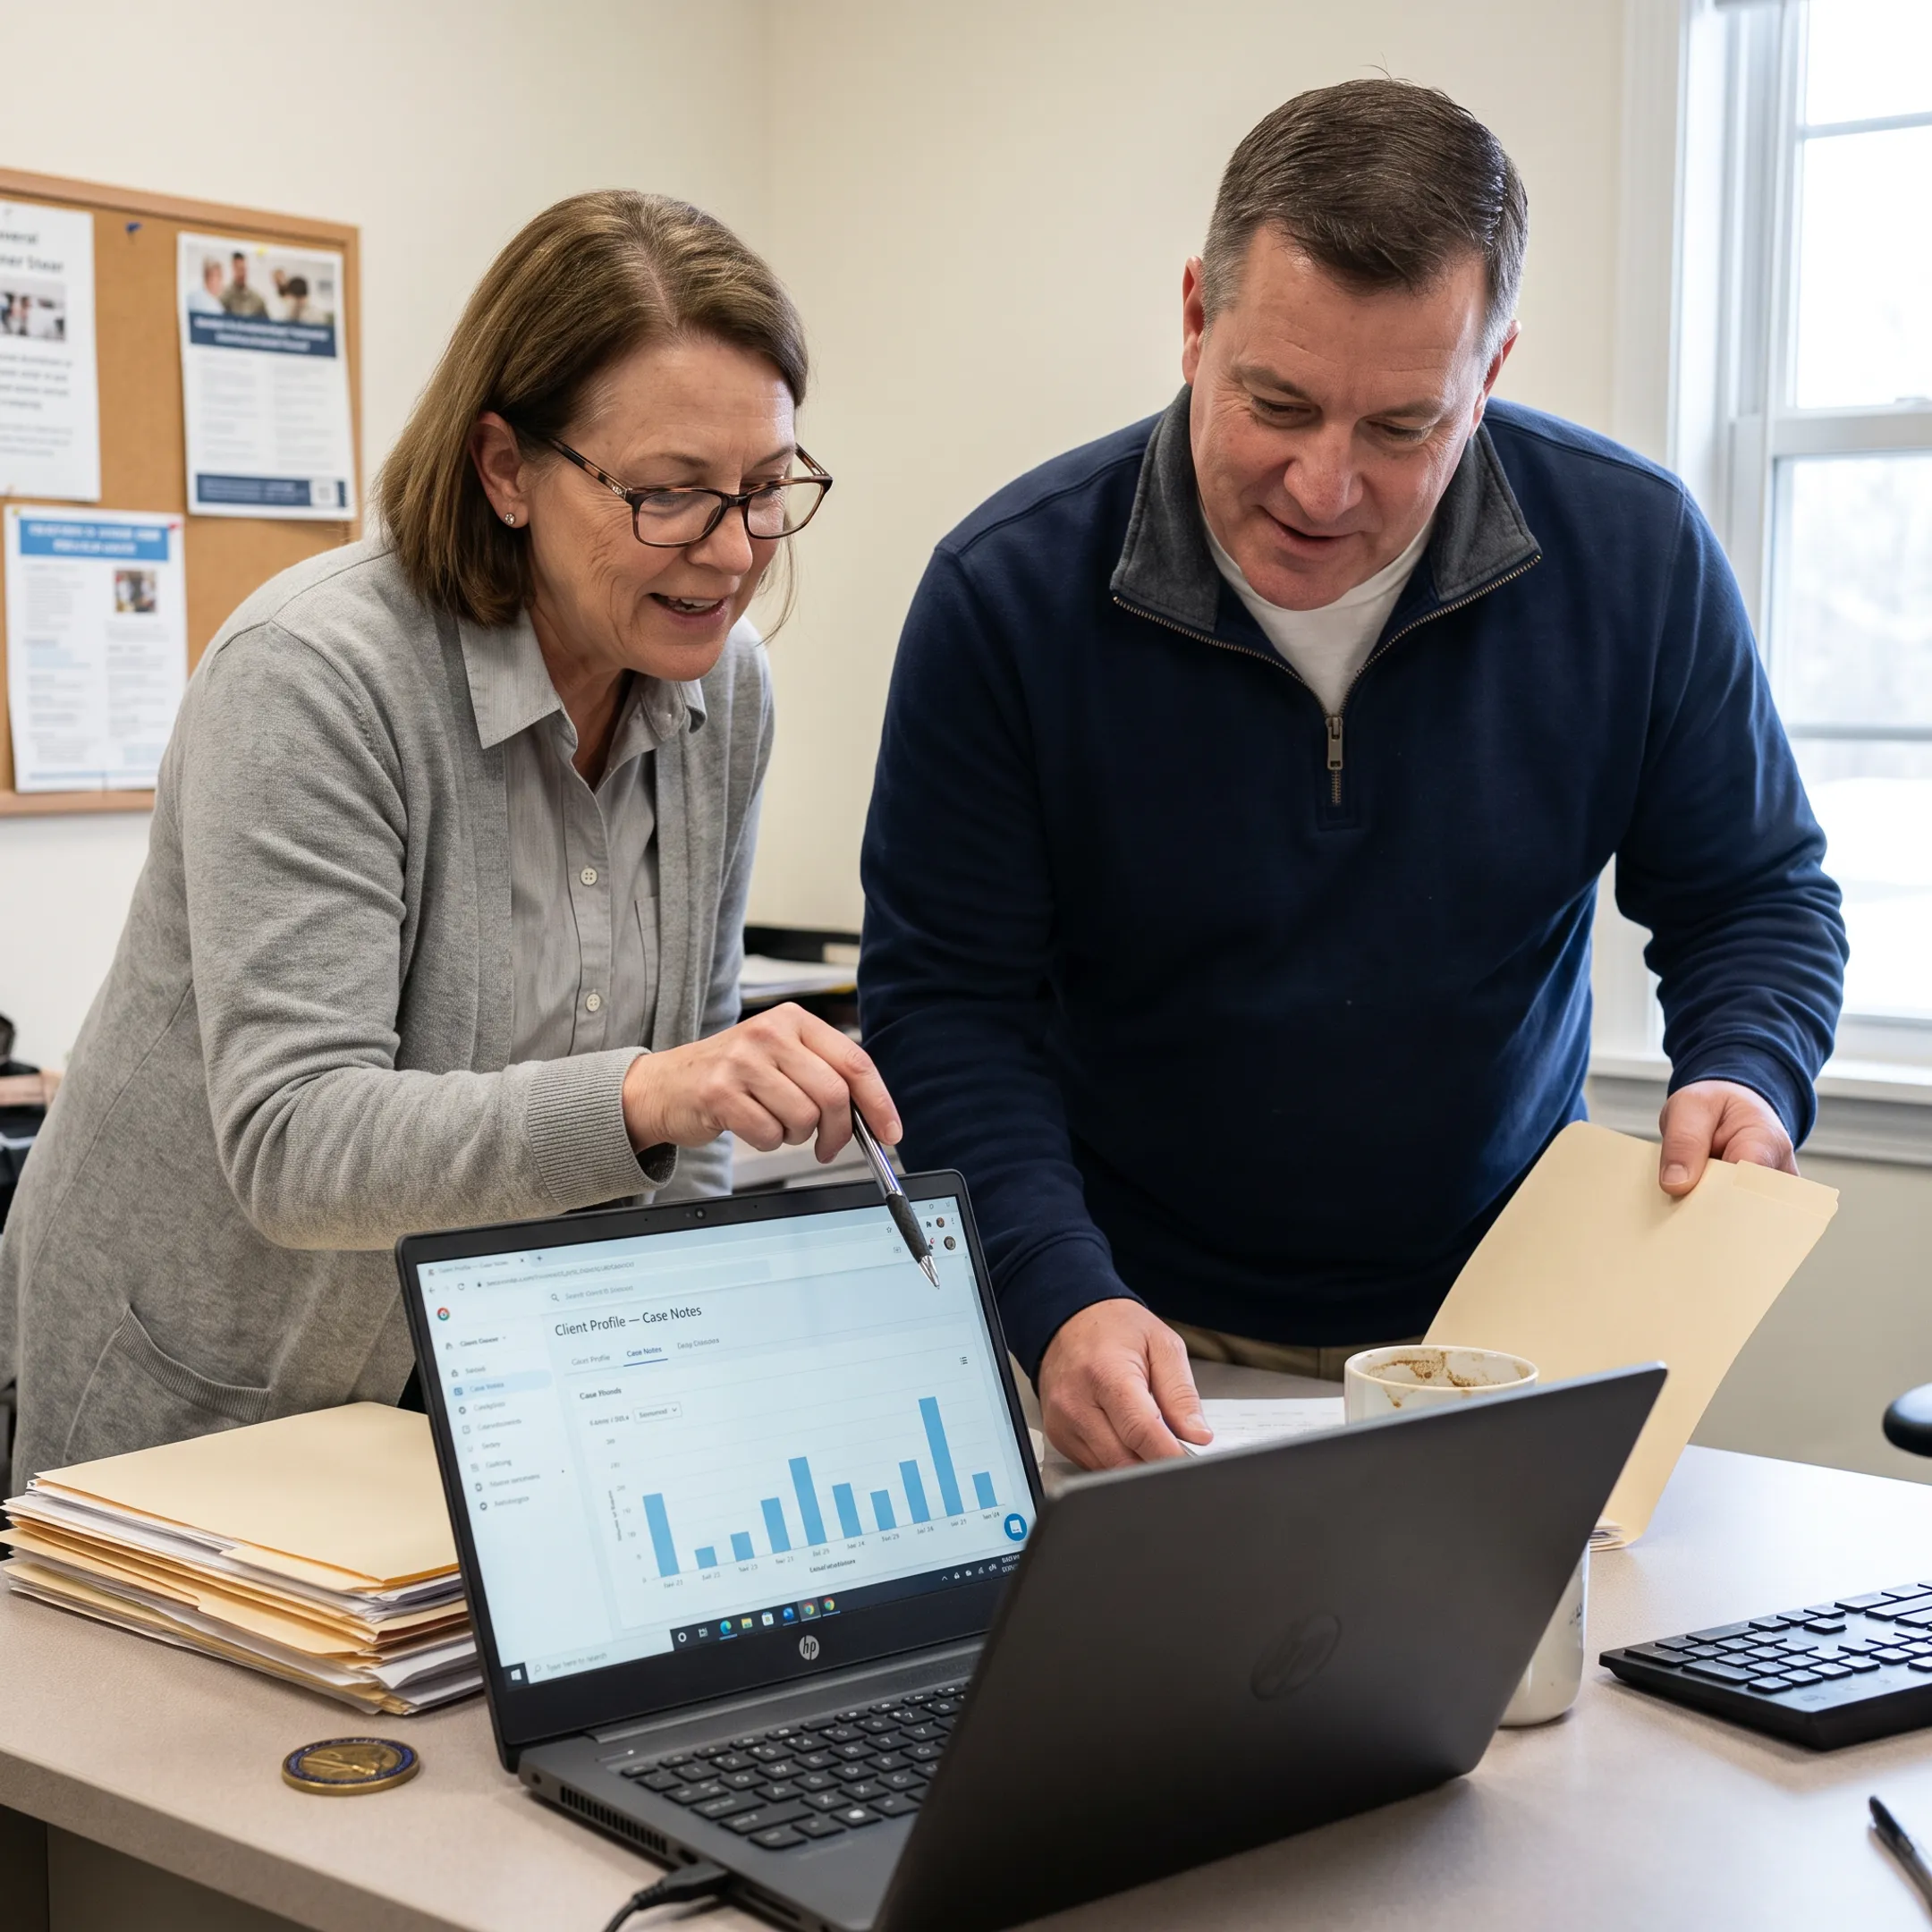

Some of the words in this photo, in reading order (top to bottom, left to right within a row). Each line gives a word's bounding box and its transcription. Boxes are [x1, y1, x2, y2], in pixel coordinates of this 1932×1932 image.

[555, 1321, 588, 1337] Client
[589, 1315, 626, 1333] Profile
[642, 1310, 668, 1325] Case
[670, 1304, 702, 1320] Notes
[626, 1350, 643, 1358] Case
[643, 1346, 663, 1355] Notes
